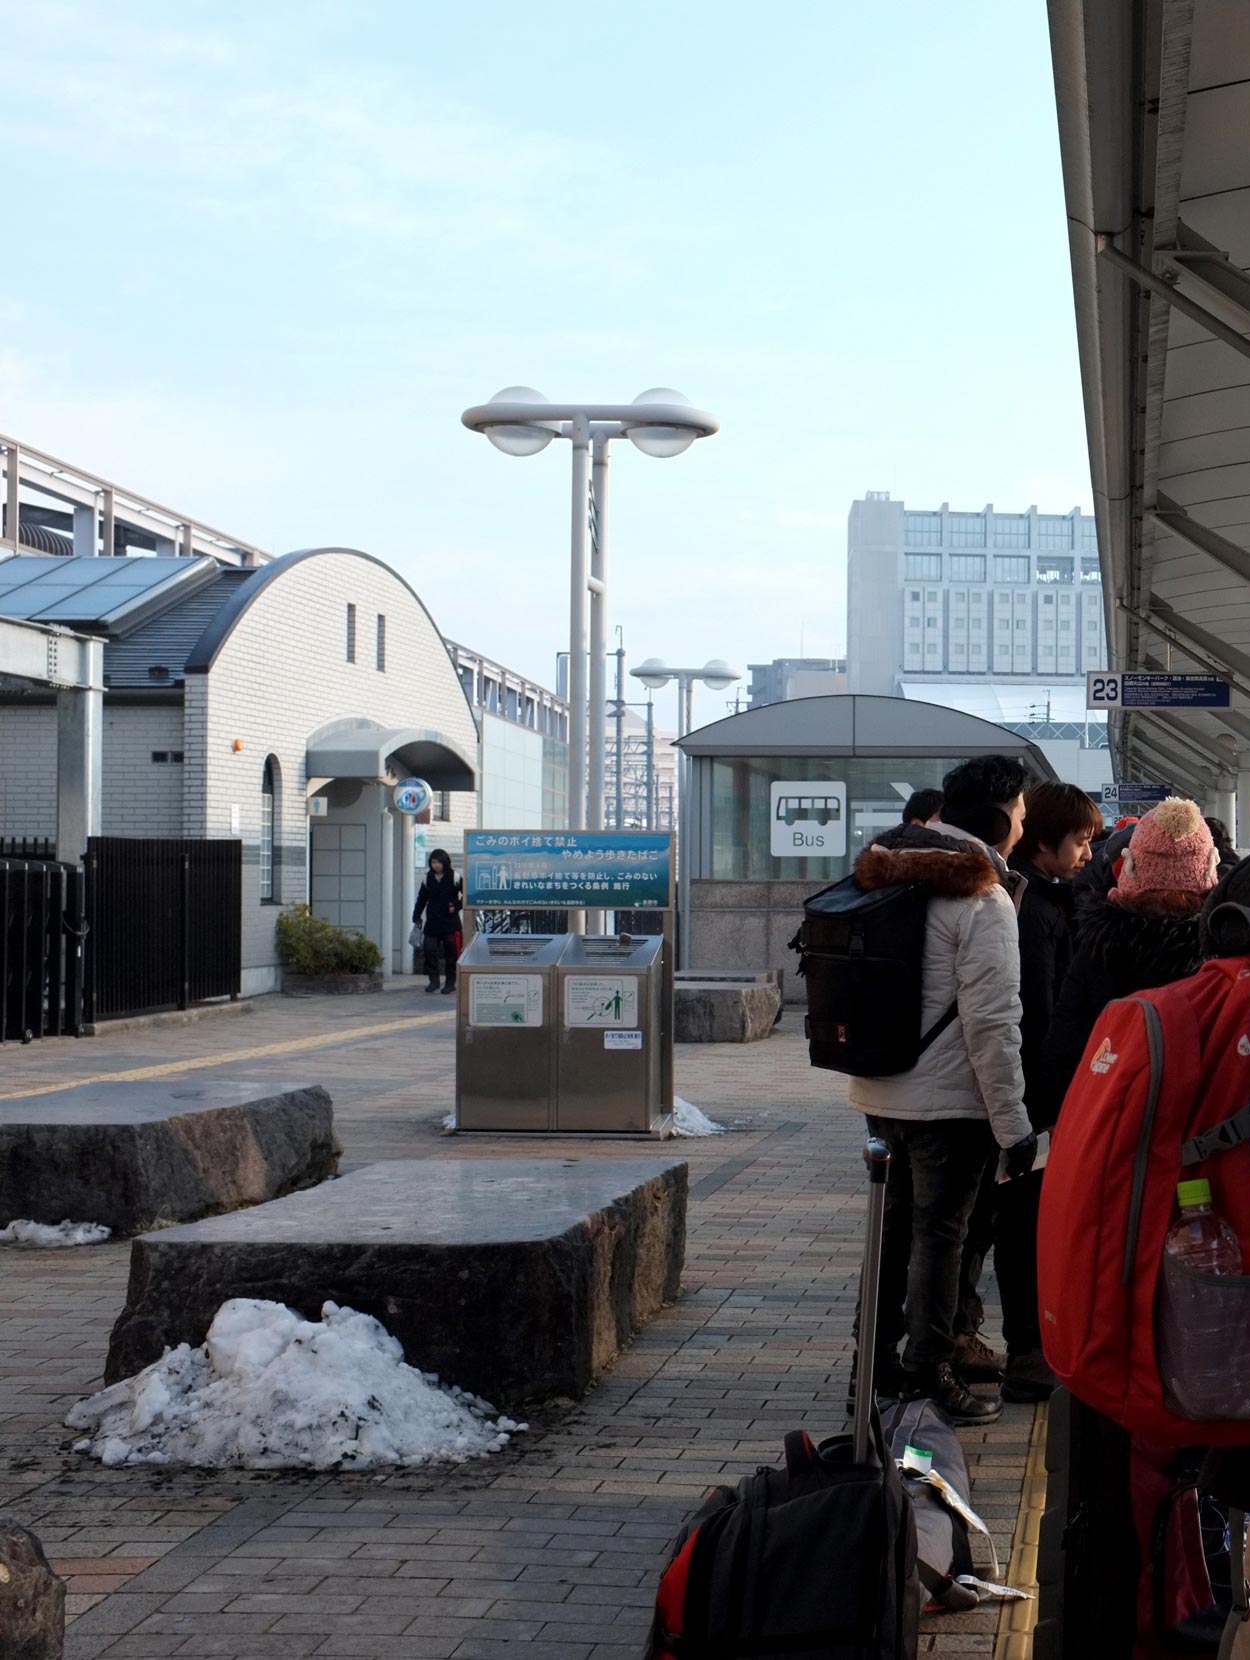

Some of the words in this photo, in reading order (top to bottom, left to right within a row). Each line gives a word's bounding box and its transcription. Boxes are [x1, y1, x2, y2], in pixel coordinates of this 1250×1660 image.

[1093, 678, 1118, 701] 23
[1104, 787, 1118, 799] 24
[475, 835, 578, 847] ごみのポイ捨て禁止
[793, 832, 825, 847] Bus
[561, 849, 658, 861] やめよう歩きたばこ
